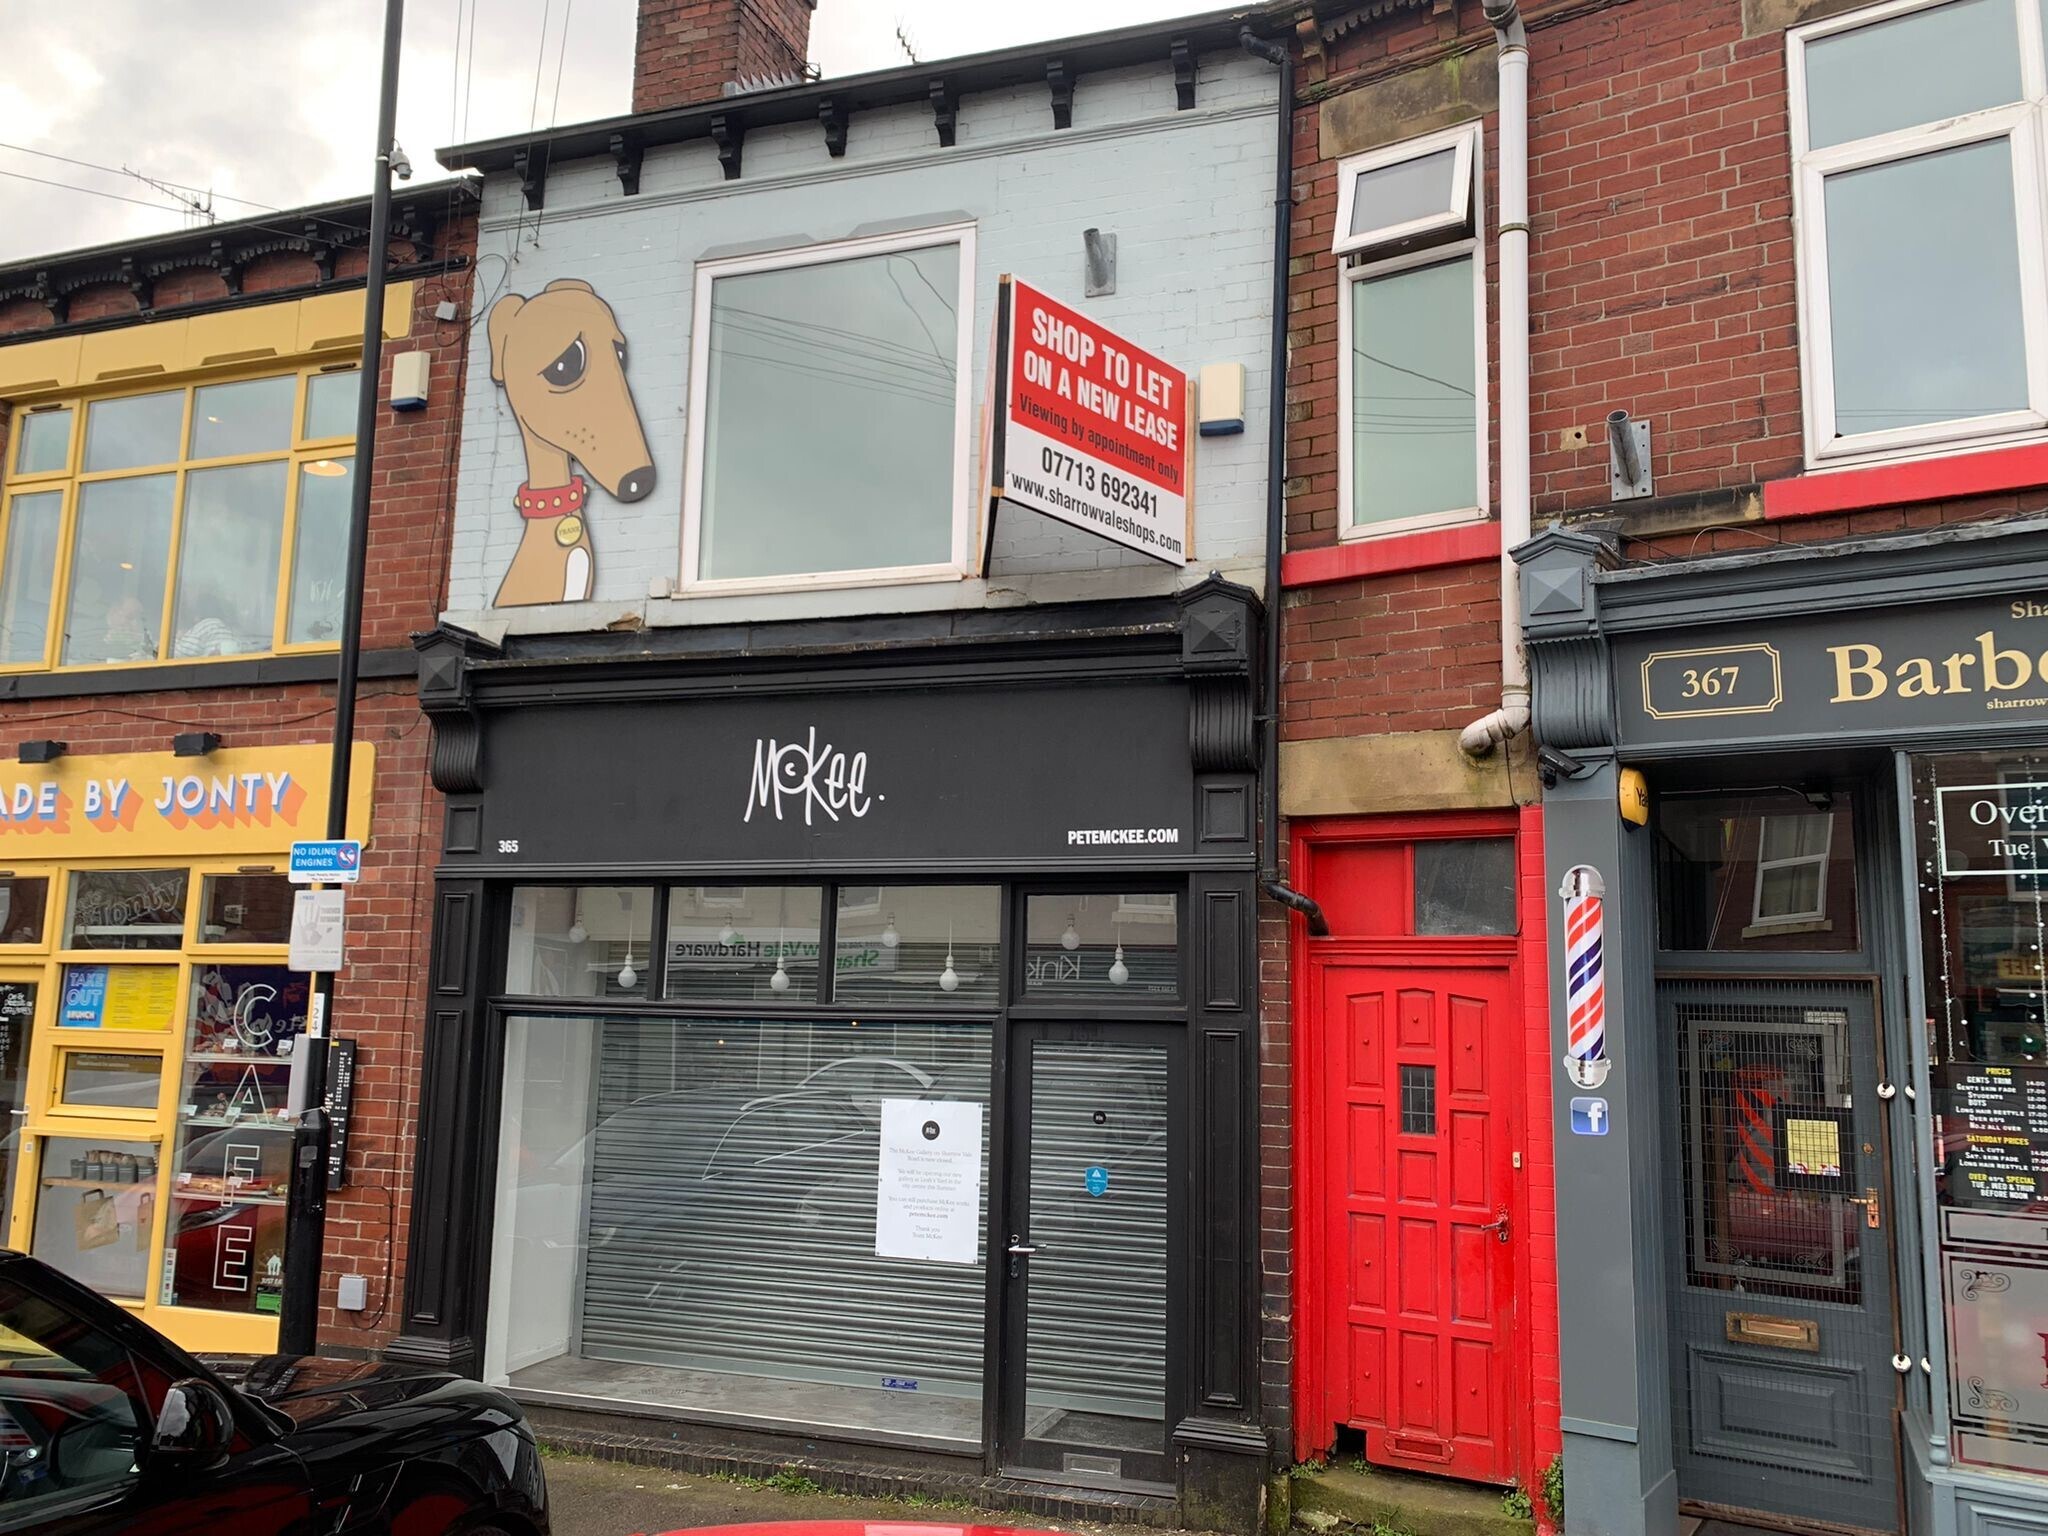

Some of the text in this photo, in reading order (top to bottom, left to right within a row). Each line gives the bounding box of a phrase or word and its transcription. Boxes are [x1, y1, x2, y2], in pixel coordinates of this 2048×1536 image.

[1032, 307, 1173, 410] SHOP TO LET
[1023, 350, 1177, 451] ON A NEW LEASE
[1019, 393, 1179, 485] Viewing by appointment only
[1042, 446, 1158, 518] 07713 692341
[1011, 473, 1182, 554] www.sharrowvaleshops.com
[1826, 631, 2048, 703] Barb
[1681, 666, 1740, 698] 367
[84, 778, 128, 813] BY
[154, 771, 290, 810] JONTY
[1067, 828, 1178, 845] PETEMCKEE.COM
[293, 847, 337, 856] NO IDLING
[498, 840, 519, 853] 365
[295, 858, 333, 867] ENGINES
[70, 972, 104, 987] TAKE
[66, 988, 102, 1006] OUT
[1985, 1067, 2012, 1075] PRICES
[1966, 1076, 1990, 1084] GENTS
[1966, 1135, 2030, 1146] SATURDAY PRICES
[1968, 1173, 1988, 1181] OVER
[2006, 1176, 2036, 1185] SPECIAL
[1980, 1189, 2008, 1198] BEFORE
[2009, 1191, 2029, 1200] NOON
